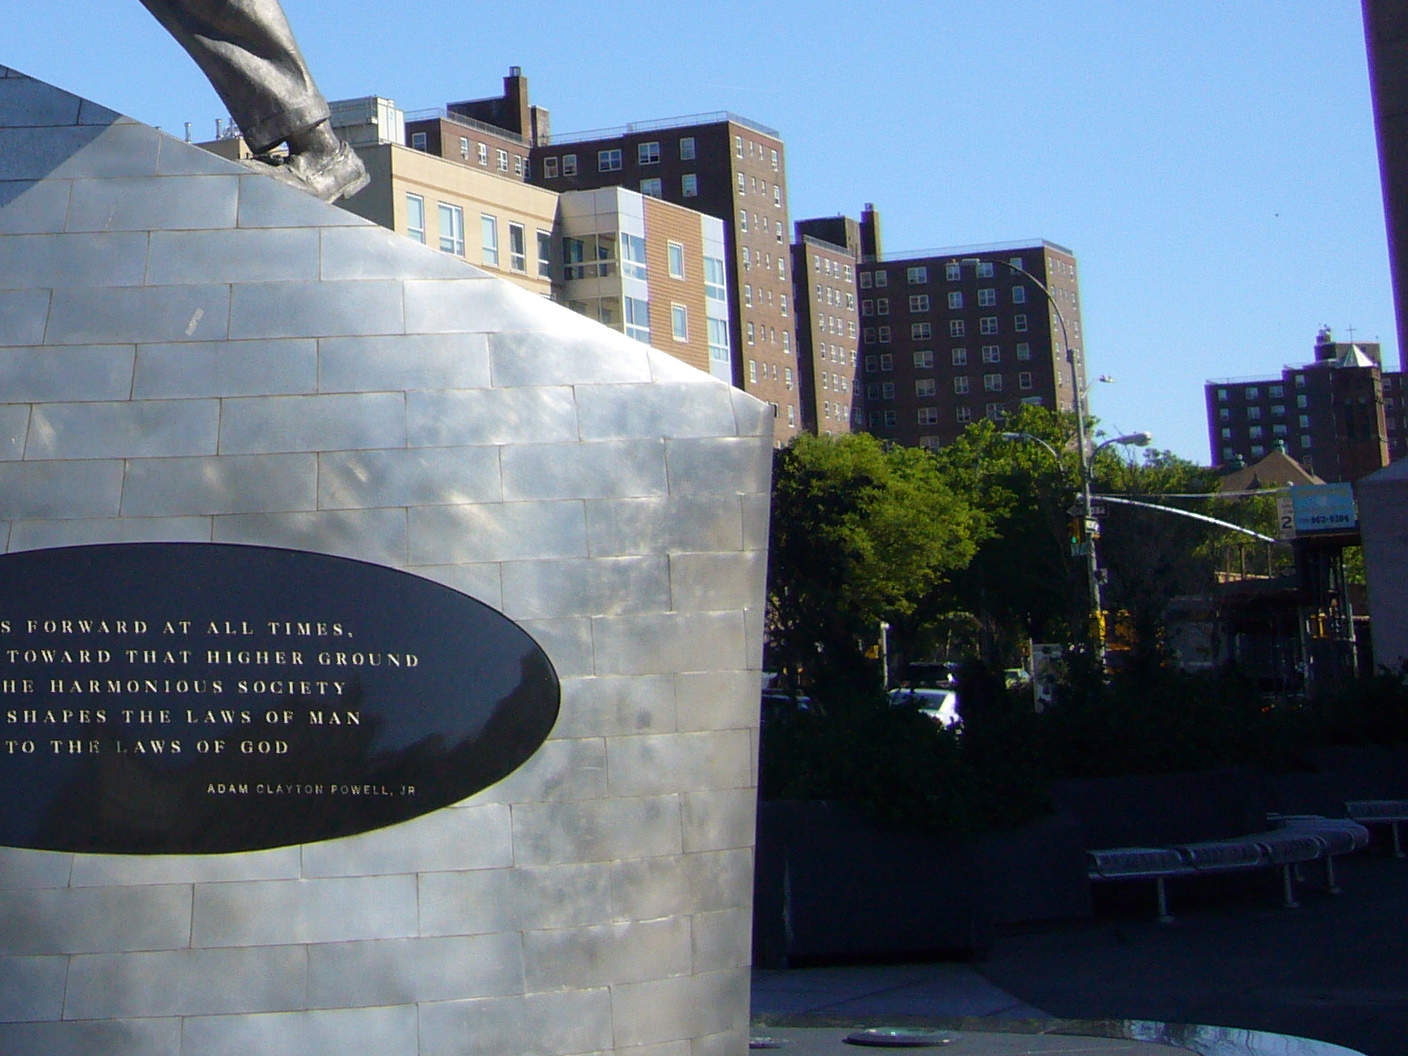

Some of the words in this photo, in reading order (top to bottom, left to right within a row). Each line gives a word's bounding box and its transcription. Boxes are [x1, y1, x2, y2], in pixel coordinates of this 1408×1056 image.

[26, 619, 148, 636] FORWARD
[162, 620, 192, 635] AT
[206, 620, 254, 636] ALL
[267, 621, 354, 639] TIMES,
[5, 648, 112, 664] TOWARD
[124, 649, 193, 665] THAT
[206, 649, 304, 666] HIGHER
[317, 651, 420, 669] GROUND
[50, 679, 224, 695] HARMONIOUS
[237, 679, 346, 696] SOCIETY
[6, 708, 107, 725] SHAPES
[121, 708, 172, 725] THE
[186, 709, 252, 725] LAWS
[265, 709, 295, 725] OF
[308, 710, 361, 726] MAN
[4, 739, 36, 755] TO
[49, 739, 101, 755] THE
[116, 739, 182, 755] LAWS
[195, 739, 226, 755] OF
[239, 739, 289, 755] GOD
[206, 782, 249, 795] ADAM
[255, 783, 324, 795] CLAYTON
[330, 783, 394, 797] POWELL,
